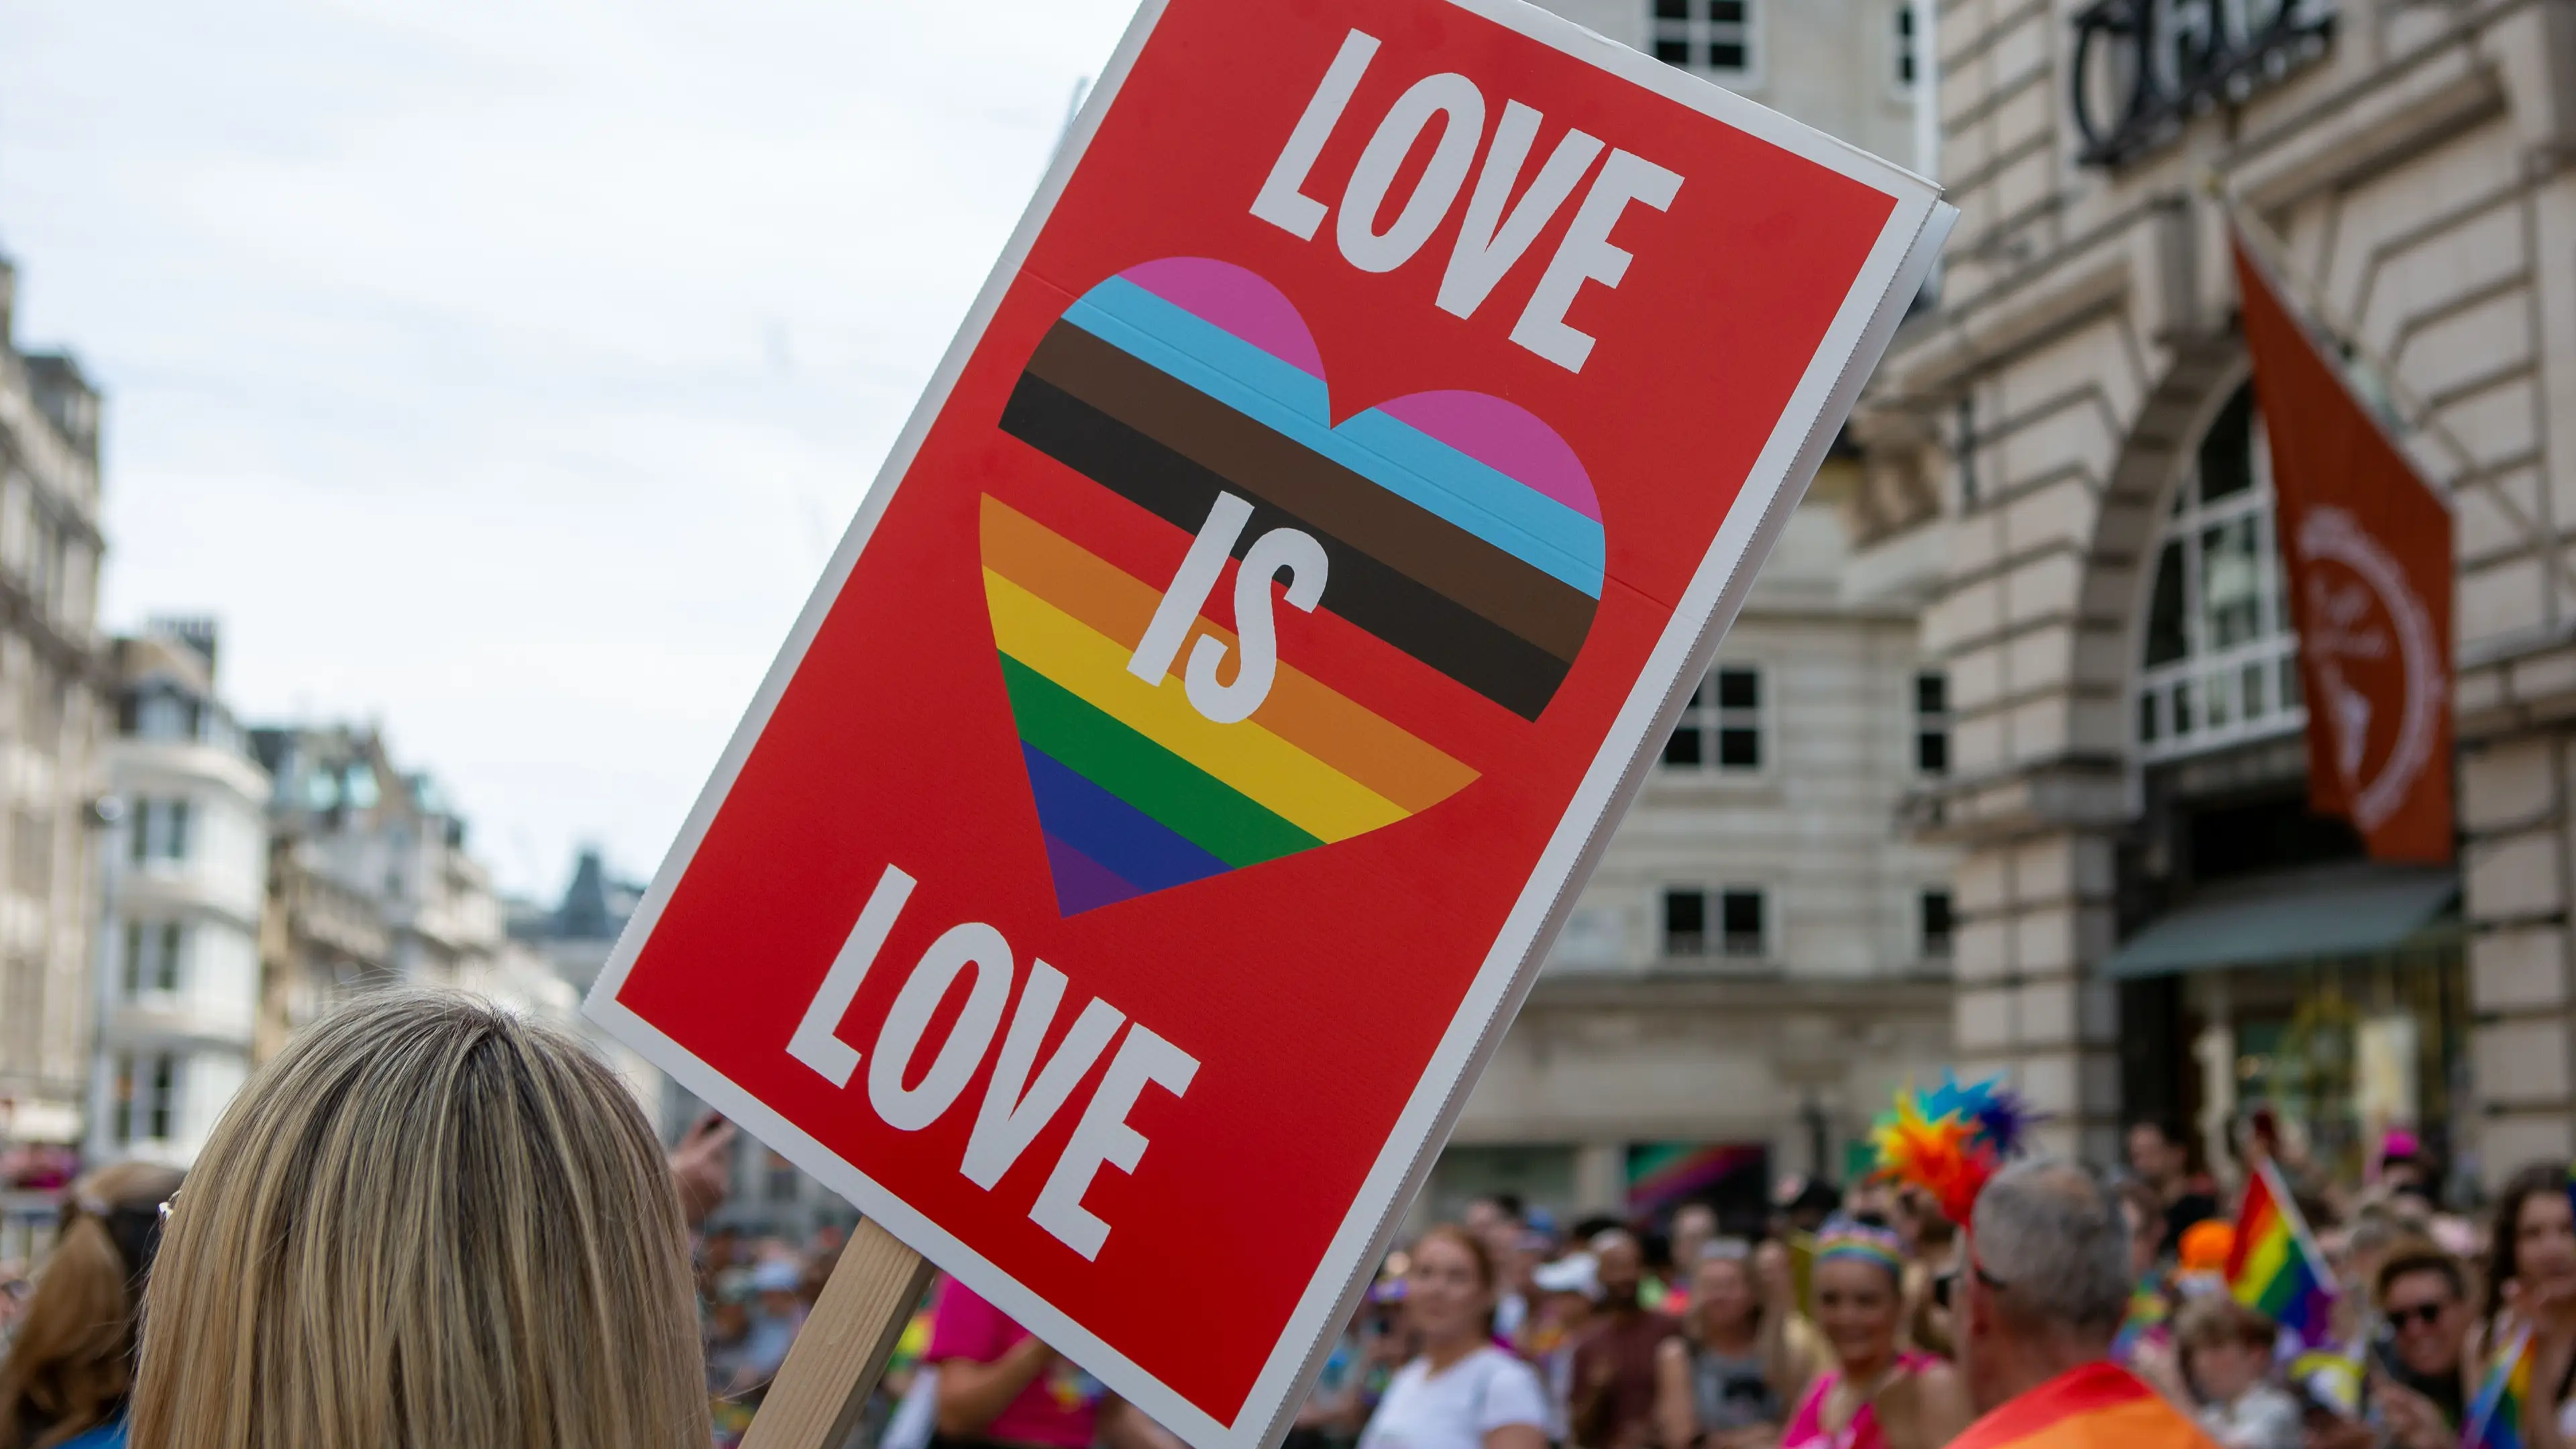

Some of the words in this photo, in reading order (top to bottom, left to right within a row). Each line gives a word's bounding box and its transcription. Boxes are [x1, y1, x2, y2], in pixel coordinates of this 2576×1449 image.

[1250, 28, 1684, 374] LOVE
[1127, 490, 1329, 724] IS
[786, 864, 1201, 1262] LOVE
